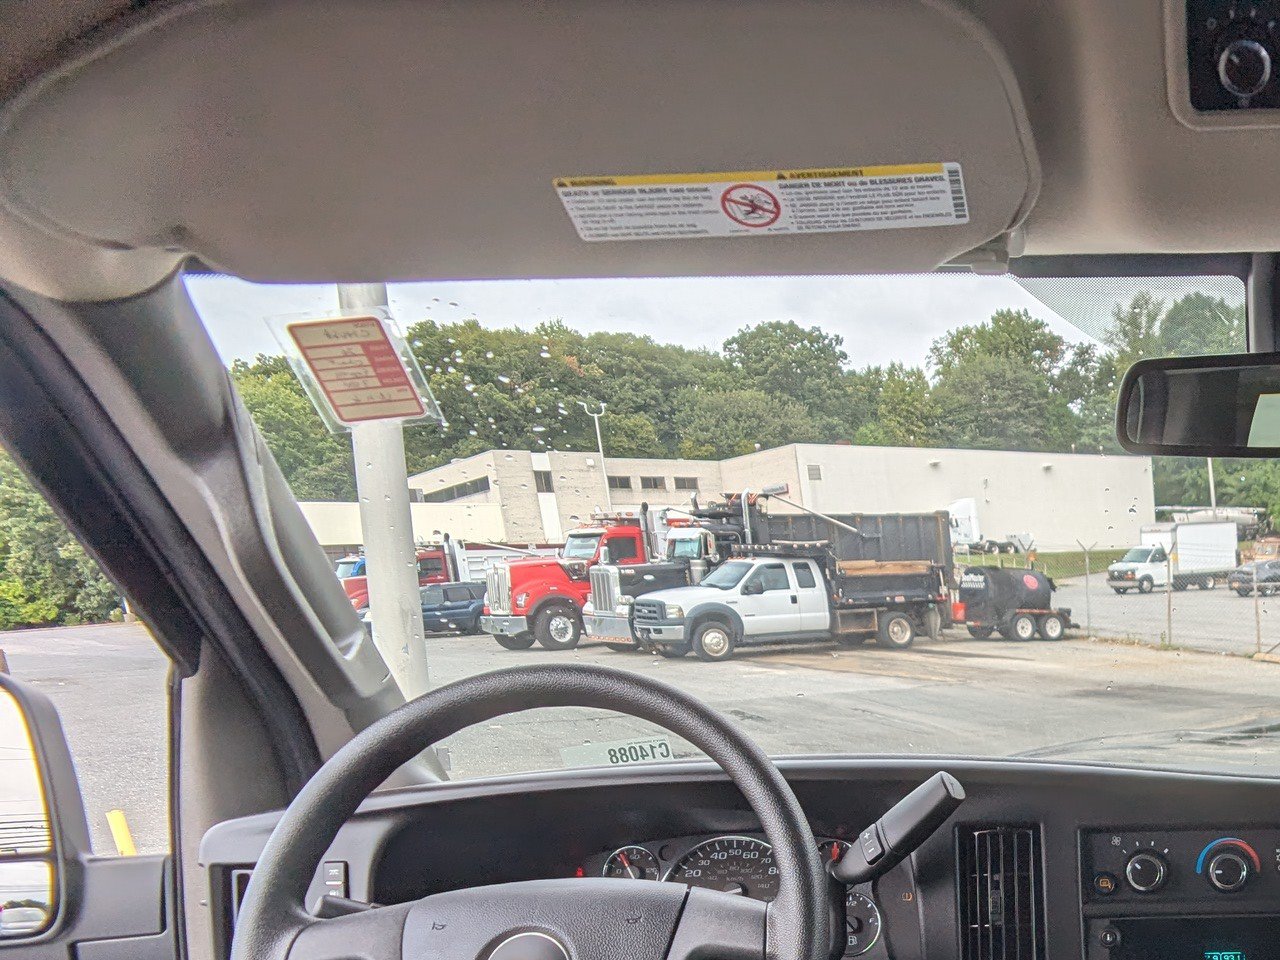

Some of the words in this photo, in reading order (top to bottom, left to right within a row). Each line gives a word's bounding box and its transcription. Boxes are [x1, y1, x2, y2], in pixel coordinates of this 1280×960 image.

[869, 177, 913, 186] BLESSURES
[710, 852, 728, 860] 40
[742, 851, 759, 860] 60
[761, 857, 772, 865] 70
[685, 869, 702, 878] 20
